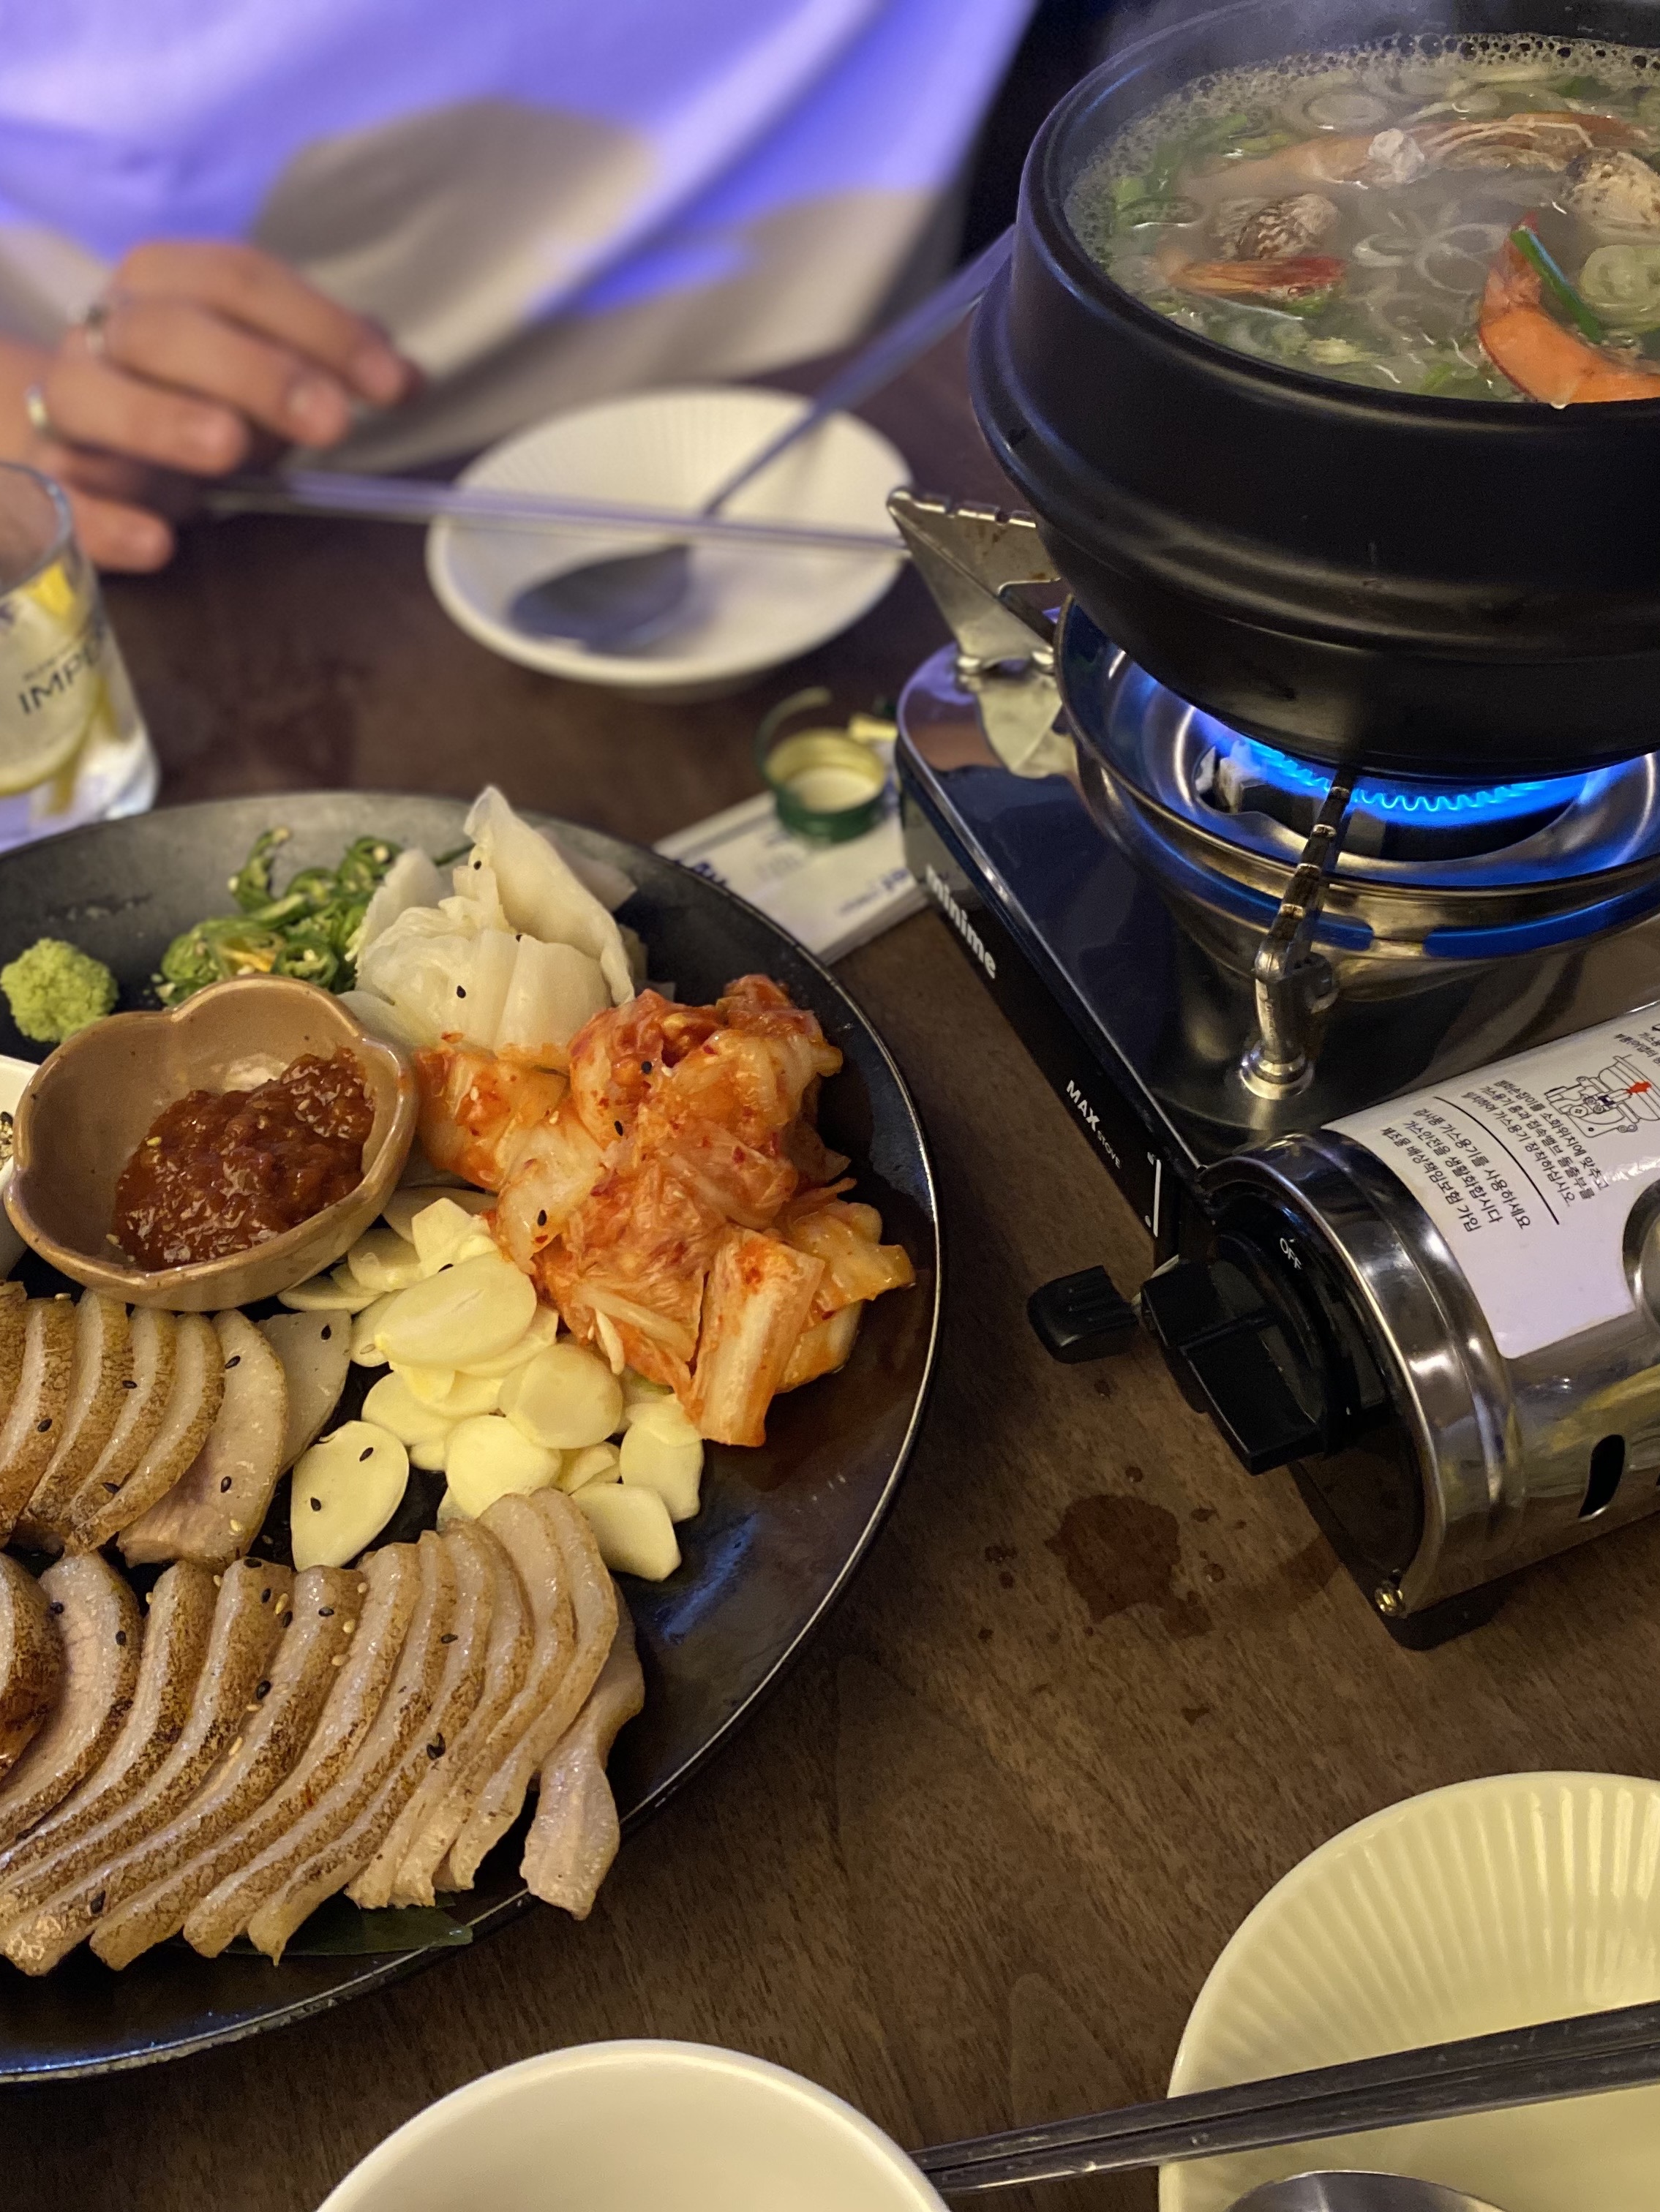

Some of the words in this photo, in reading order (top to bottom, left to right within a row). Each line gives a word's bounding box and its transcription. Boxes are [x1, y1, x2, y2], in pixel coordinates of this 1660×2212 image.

[1066, 1080, 1100, 1133] MAX
[1096, 1130, 1122, 1169] STOVE
[1402, 1120, 1451, 1156] 가스안전을
[1444, 1156, 1503, 1223] 생활화합시다
[1413, 1107, 1446, 1126] 검사품
[1440, 1124, 1490, 1167] 가스용기를
[1484, 1169, 1531, 1230] 사용하세요
[1479, 1086, 1515, 1107] 가스용기
[1525, 1119, 1564, 1156] 접속밸브
[1557, 1156, 1595, 1200] 돌출부를
[1493, 1111, 1531, 1143] 가스용기
[1540, 1113, 1586, 1156] 소화위치에
[1580, 1156, 1610, 1191] 맞추고
[1381, 1127, 1411, 1147] 제조물
[1406, 1146, 1464, 1205] 배상책임보험
[1457, 1205, 1482, 1232] 가입
[1280, 1237, 1302, 1271] OFF
